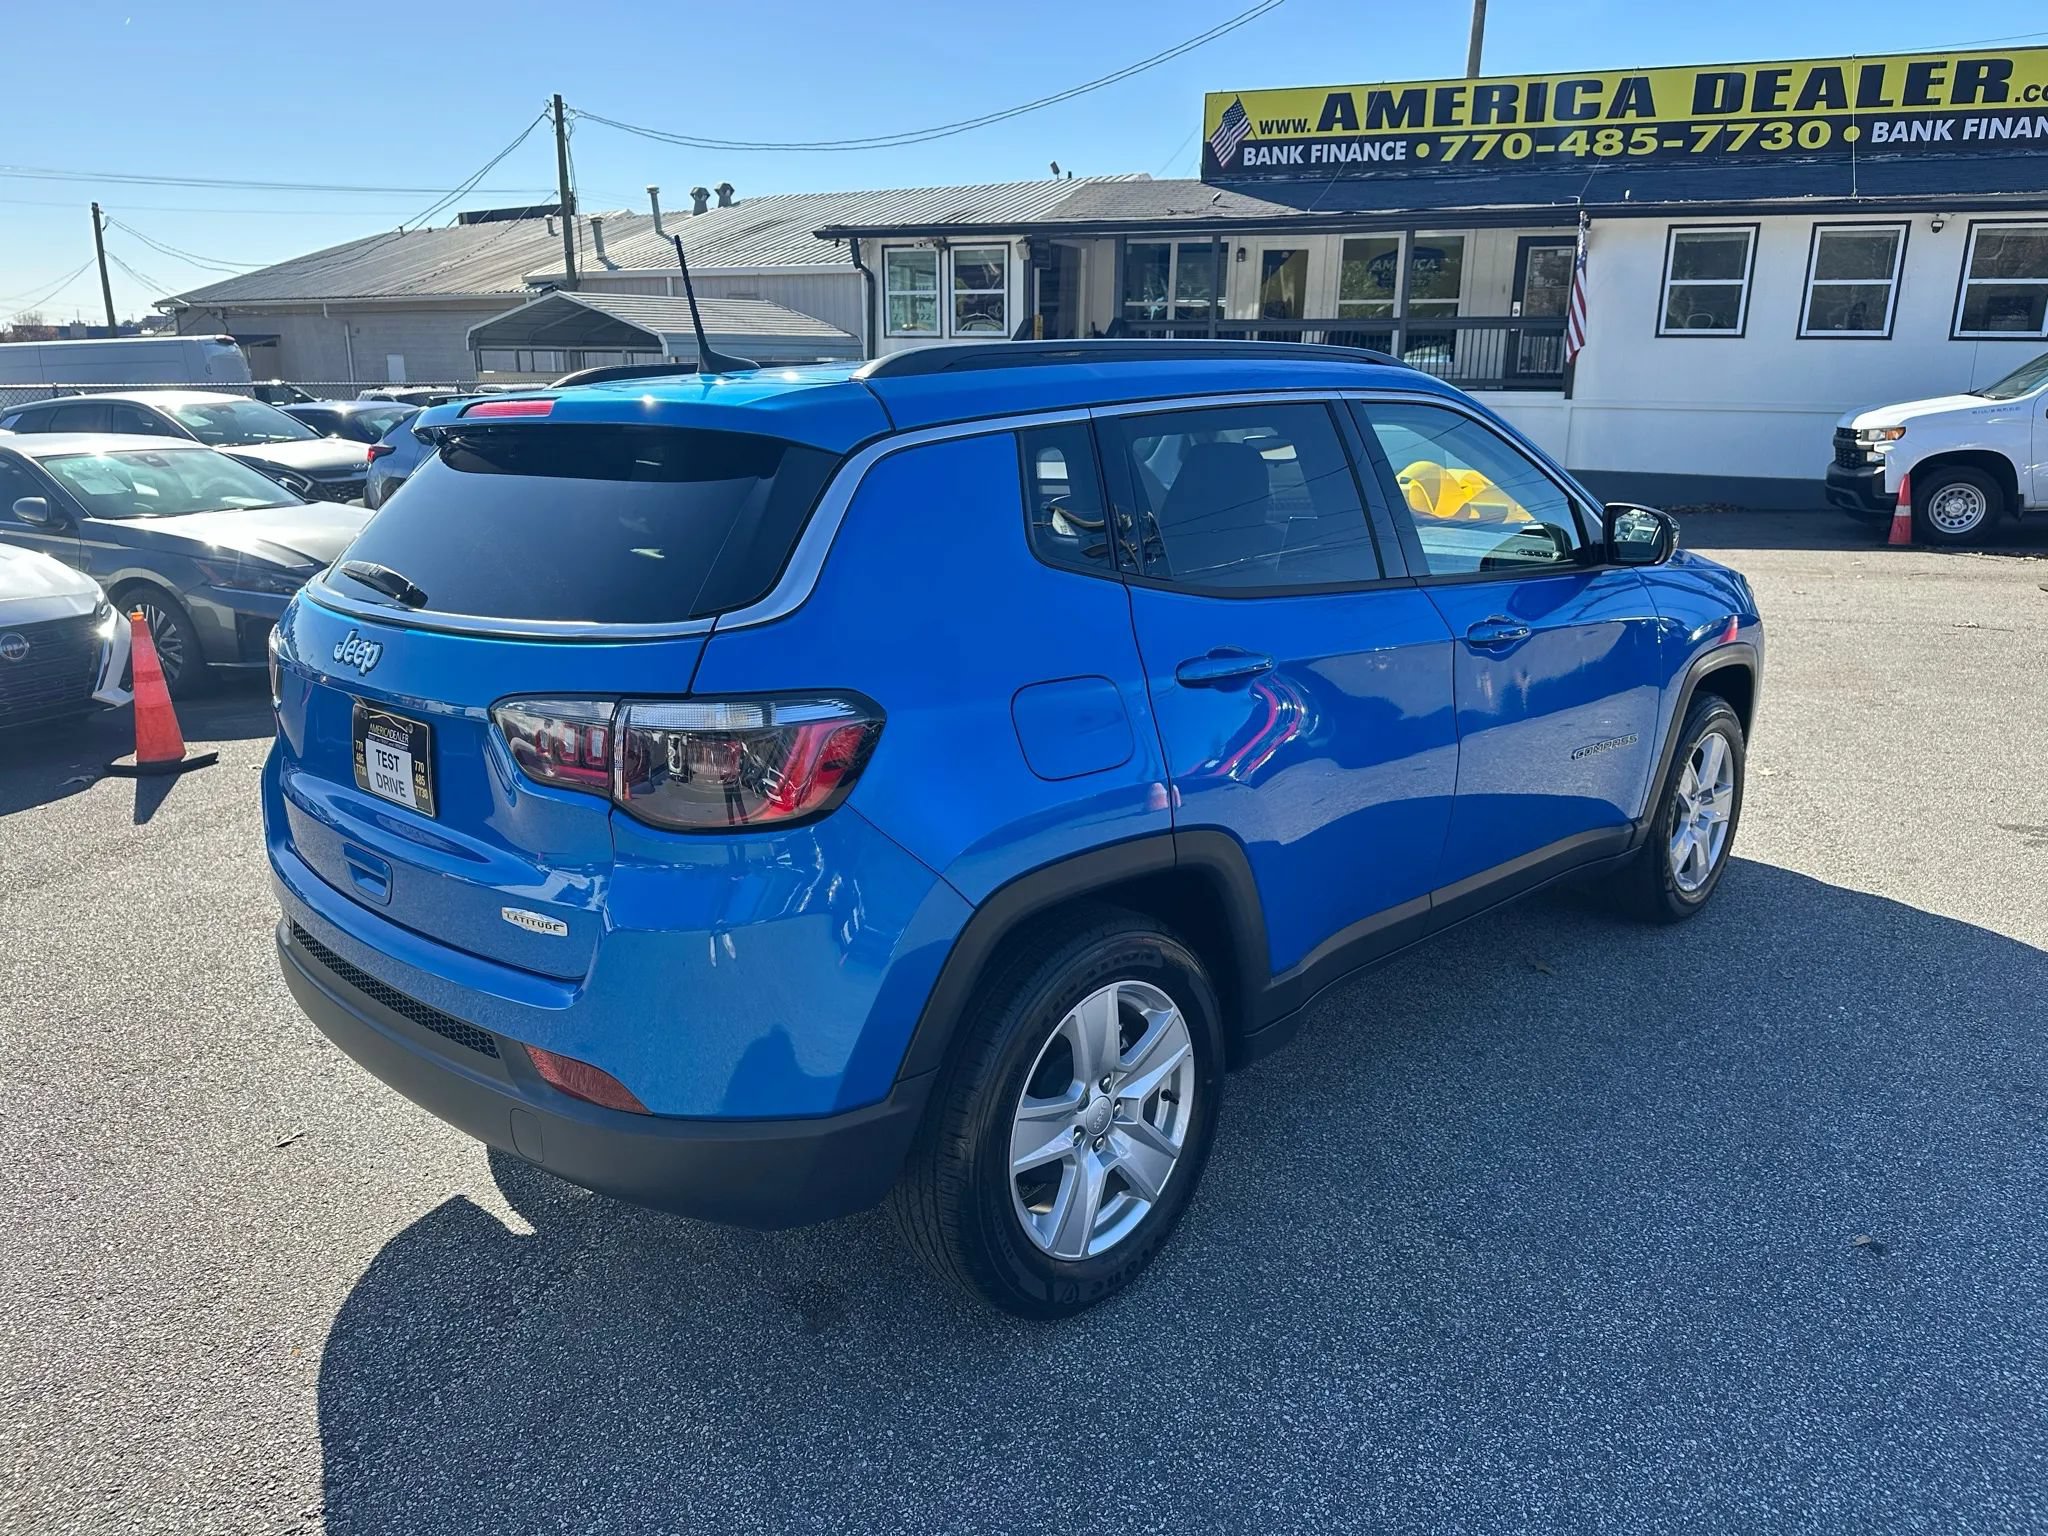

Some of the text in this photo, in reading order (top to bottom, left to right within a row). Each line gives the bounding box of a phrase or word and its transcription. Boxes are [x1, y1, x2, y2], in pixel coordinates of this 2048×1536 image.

[1258, 117, 1312, 135] www.
[1316, 76, 1657, 132] AMERICA
[1691, 58, 2014, 116] DEALER
[1243, 143, 1305, 167] BANK
[1310, 140, 1407, 164] FINANCE
[1439, 119, 1832, 162] 770-485-7730
[1871, 118, 1957, 144] BANK
[1370, 258, 1438, 272] AMICA
[333, 629, 383, 677] Jeep
[1574, 734, 1639, 760] COMPASS
[375, 748, 400, 773] TEST
[414, 760, 425, 773] 770
[375, 771, 407, 798] DRIVE
[505, 911, 561, 932] LATITUDE
